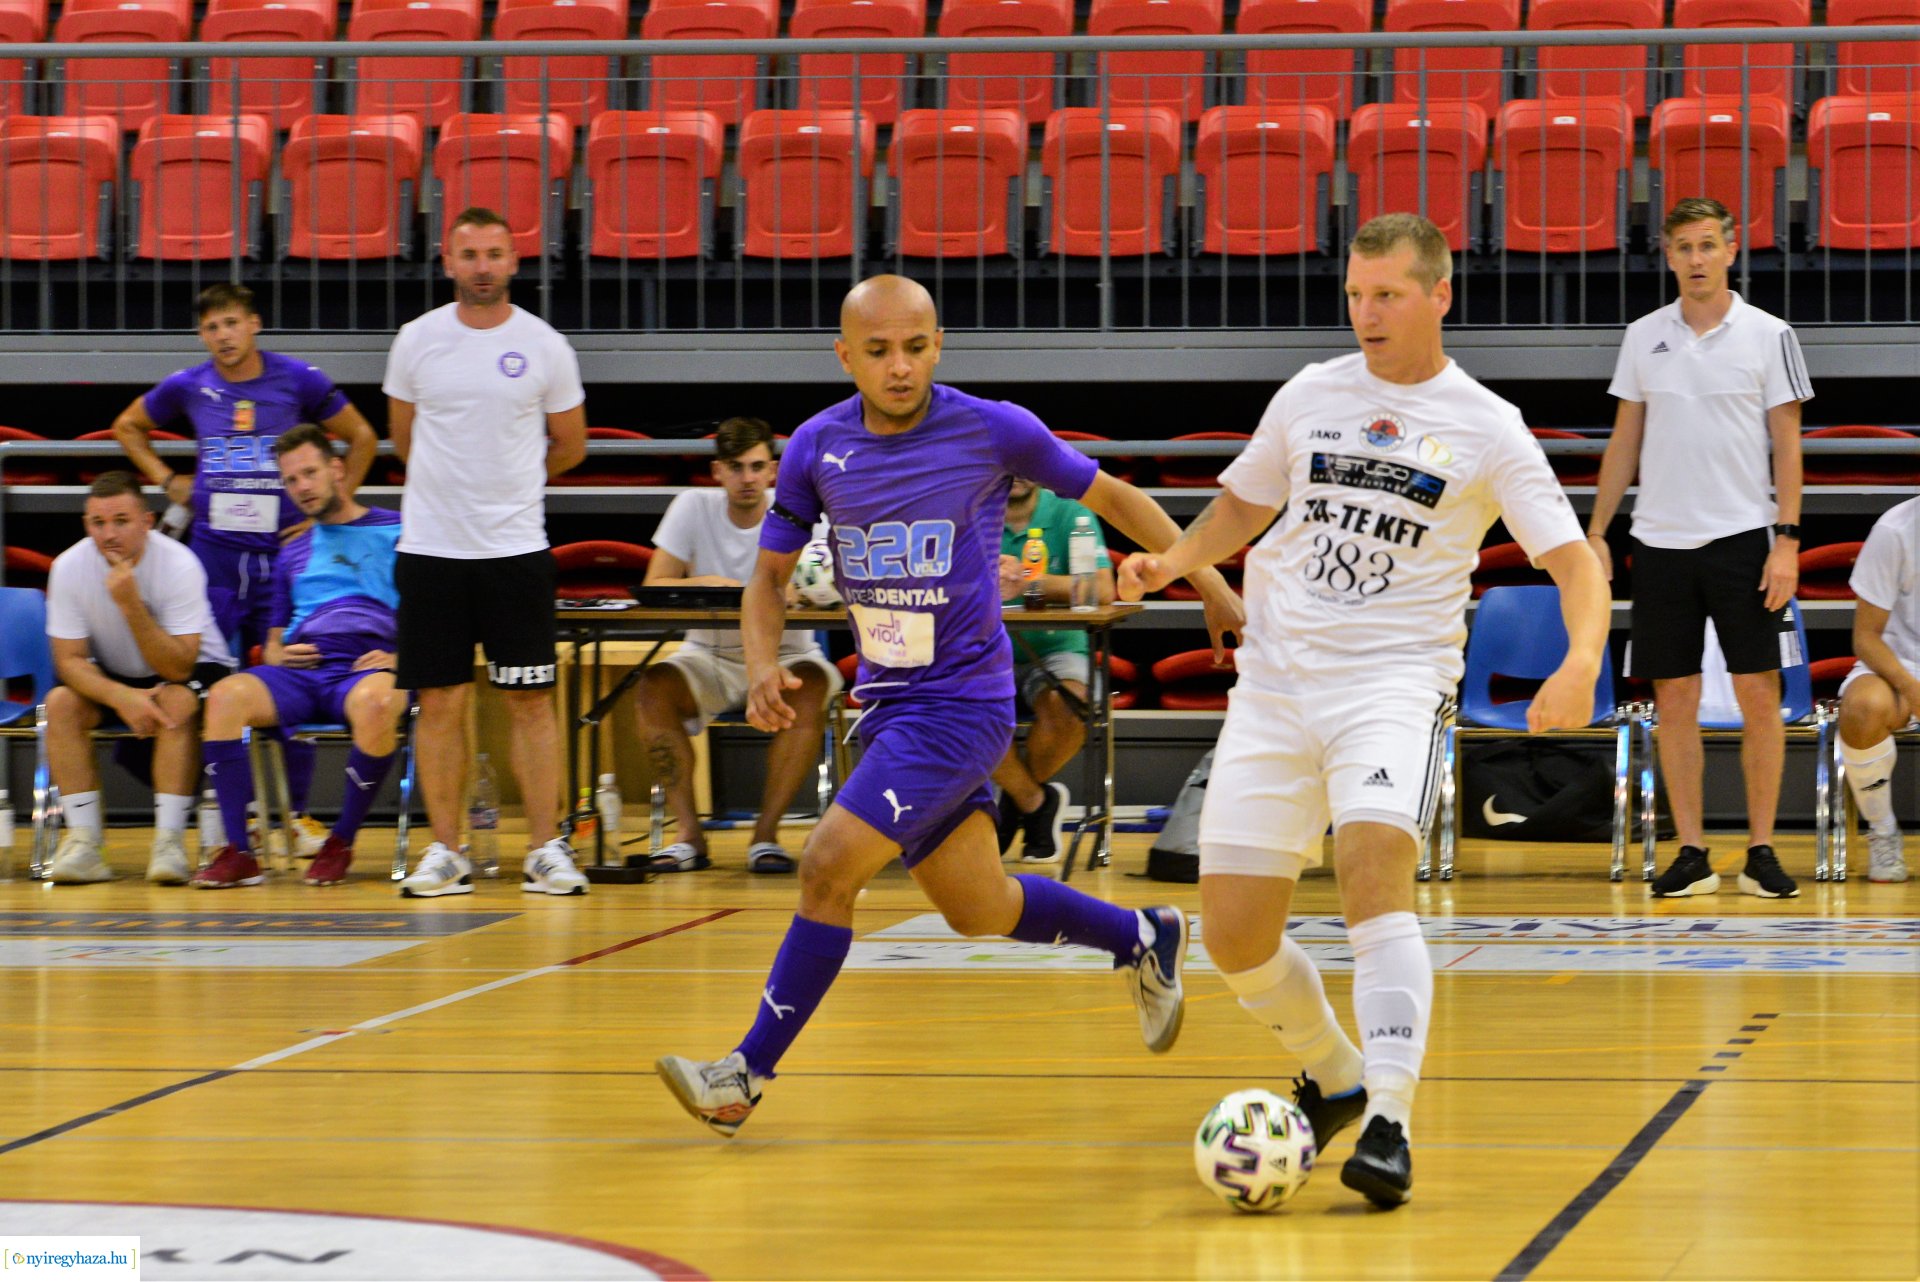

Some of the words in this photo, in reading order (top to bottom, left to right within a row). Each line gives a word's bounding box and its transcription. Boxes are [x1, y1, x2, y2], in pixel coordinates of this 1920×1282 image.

[1309, 429, 1342, 441] JAKO
[1373, 513, 1430, 549] KFT
[832, 519, 956, 581] 220
[914, 561, 946, 574] VOLT
[1304, 533, 1395, 597] 383
[1368, 1025, 1414, 1041] JAKO
